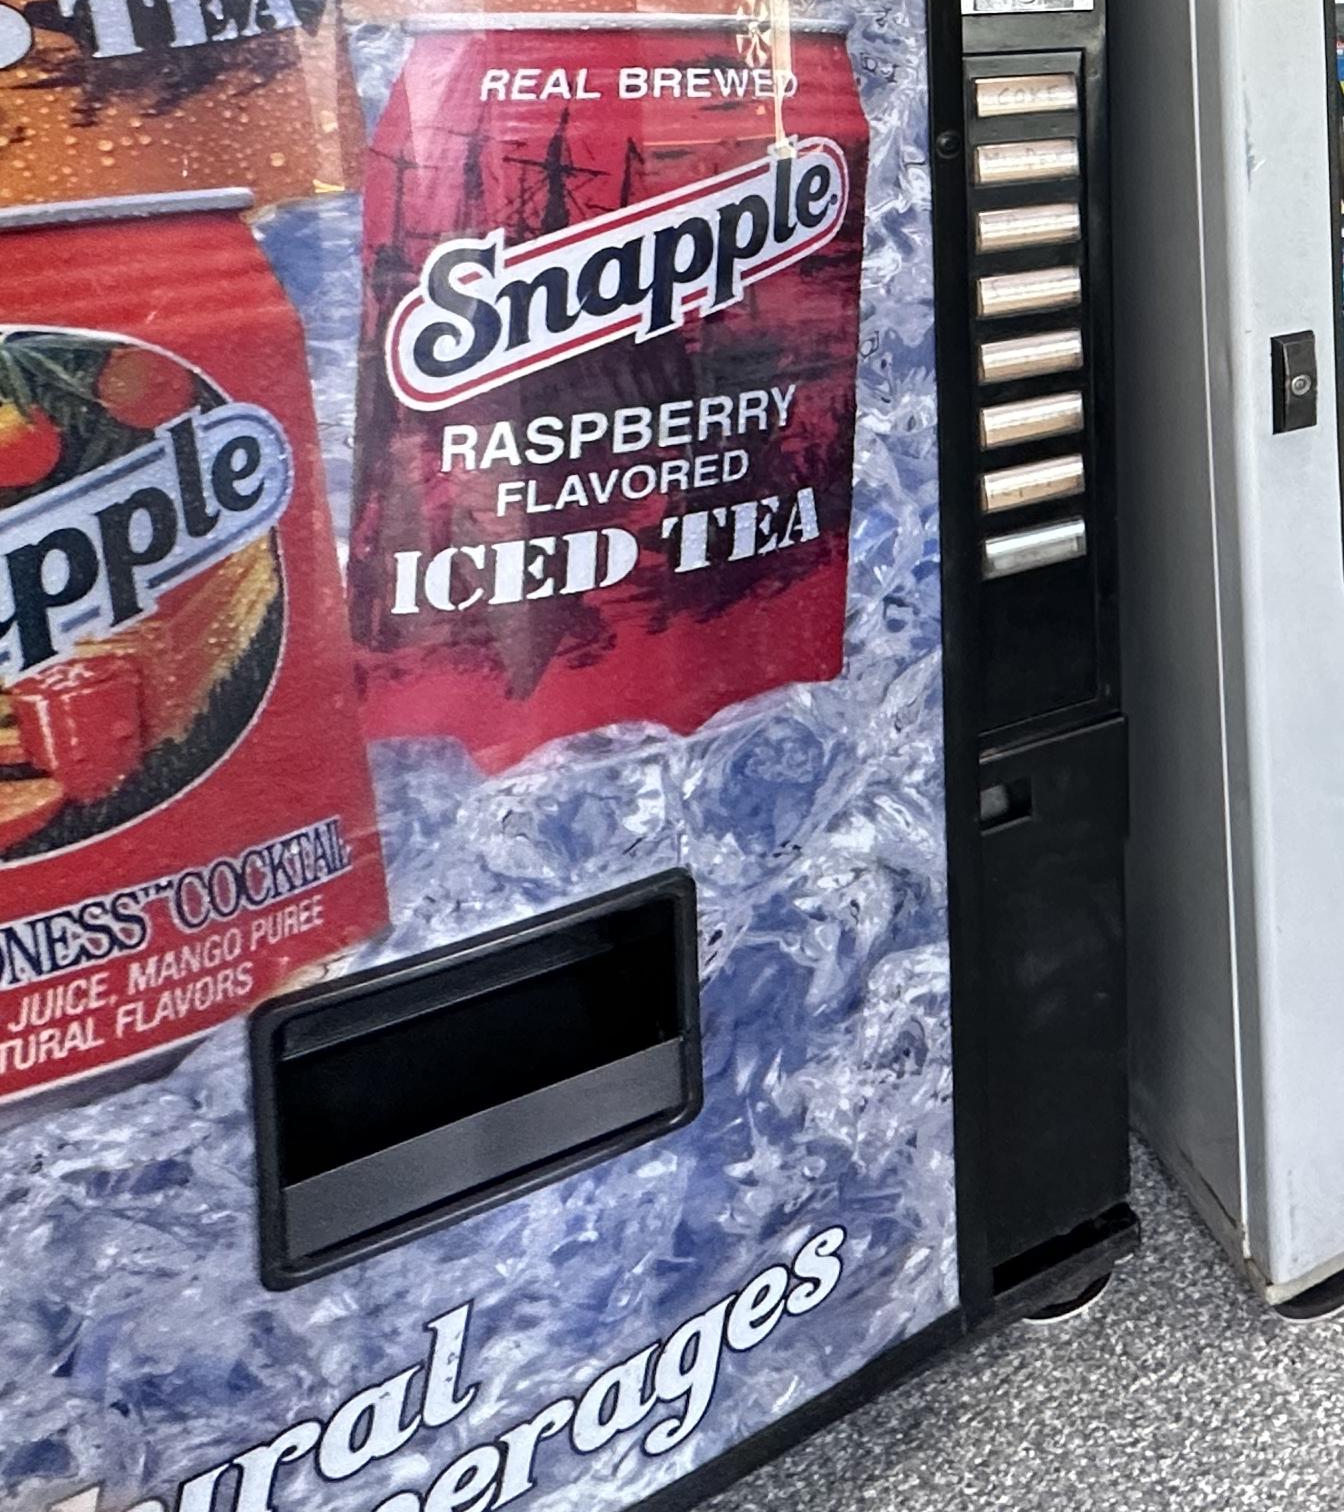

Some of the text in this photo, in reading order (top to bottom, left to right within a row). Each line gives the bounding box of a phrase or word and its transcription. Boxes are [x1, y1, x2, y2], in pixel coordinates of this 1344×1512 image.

[480, 67, 798, 102] REAL BREWED
[412, 160, 834, 379] Snapple
[441, 384, 798, 472] RASPBERRY
[498, 449, 749, 517] FLAVORED
[0, 417, 266, 672] pple
[391, 488, 821, 618] ICED TEA
[8, 895, 324, 1032] JUICE, MANGO PUREE
[116, 962, 253, 1037] FLAVORS
[372, 1225, 846, 1512] erages
